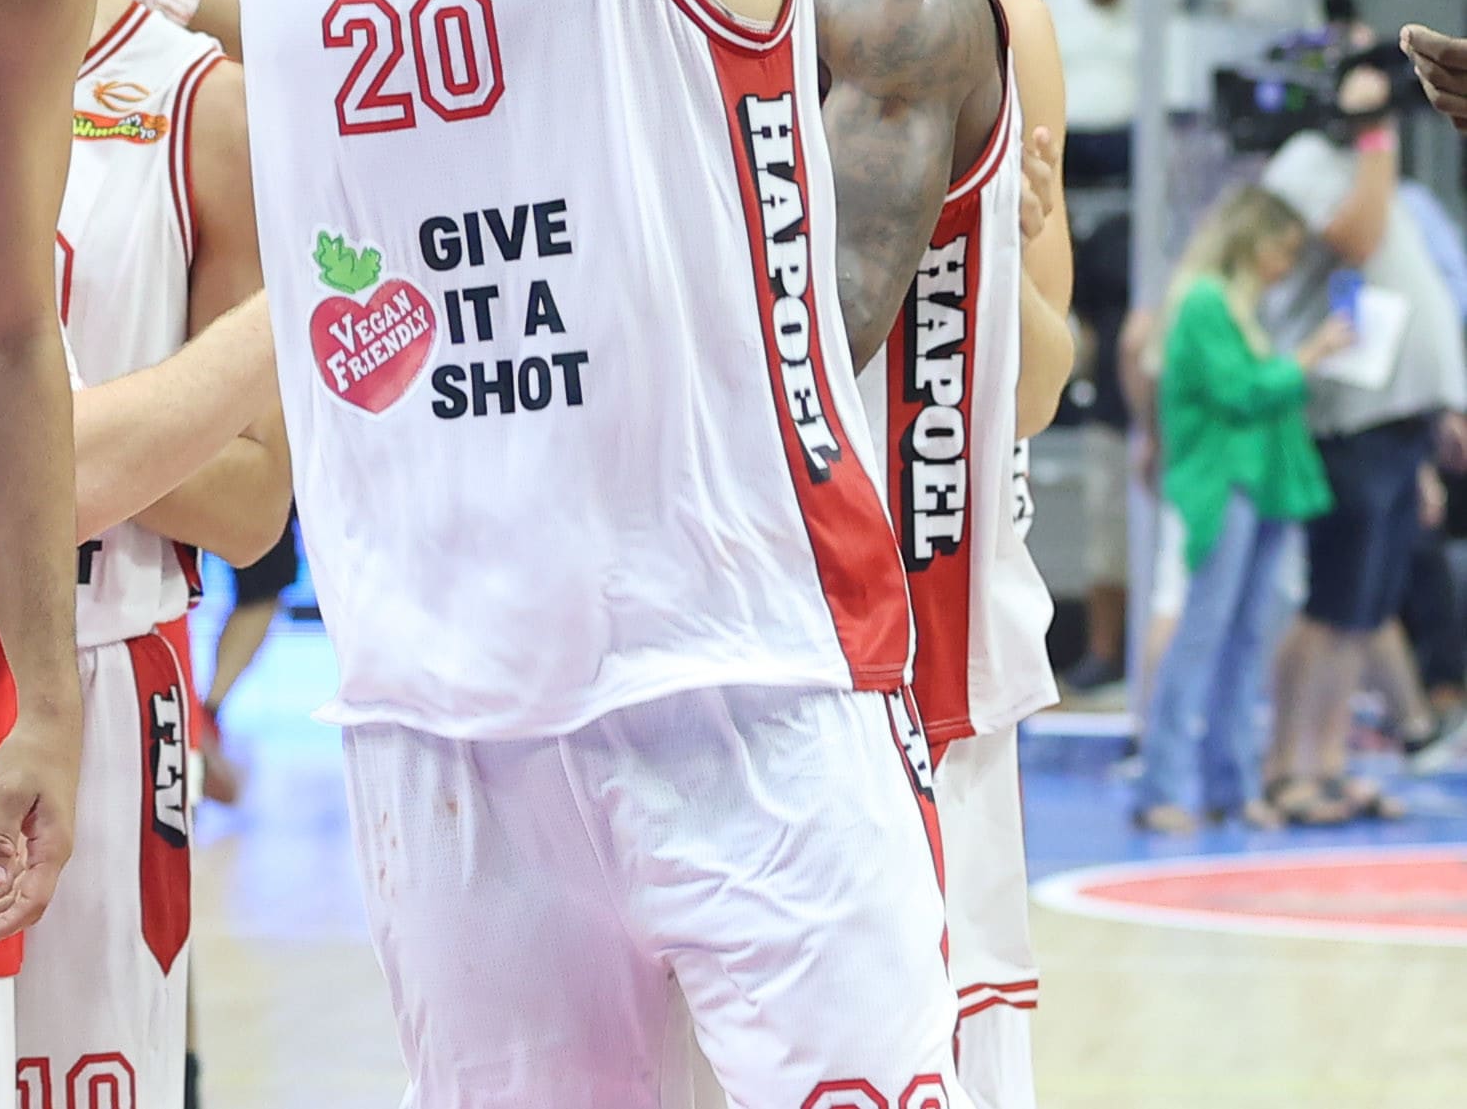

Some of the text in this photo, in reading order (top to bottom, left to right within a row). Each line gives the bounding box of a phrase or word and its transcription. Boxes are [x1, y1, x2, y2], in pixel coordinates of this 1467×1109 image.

[419, 198, 572, 272] GIVE
[737, 92, 841, 484] HAPOEL
[444, 279, 566, 344] IT A
[431, 350, 589, 419] SHOT
[904, 235, 967, 568] HAPOEL
[151, 685, 188, 844] TLV
